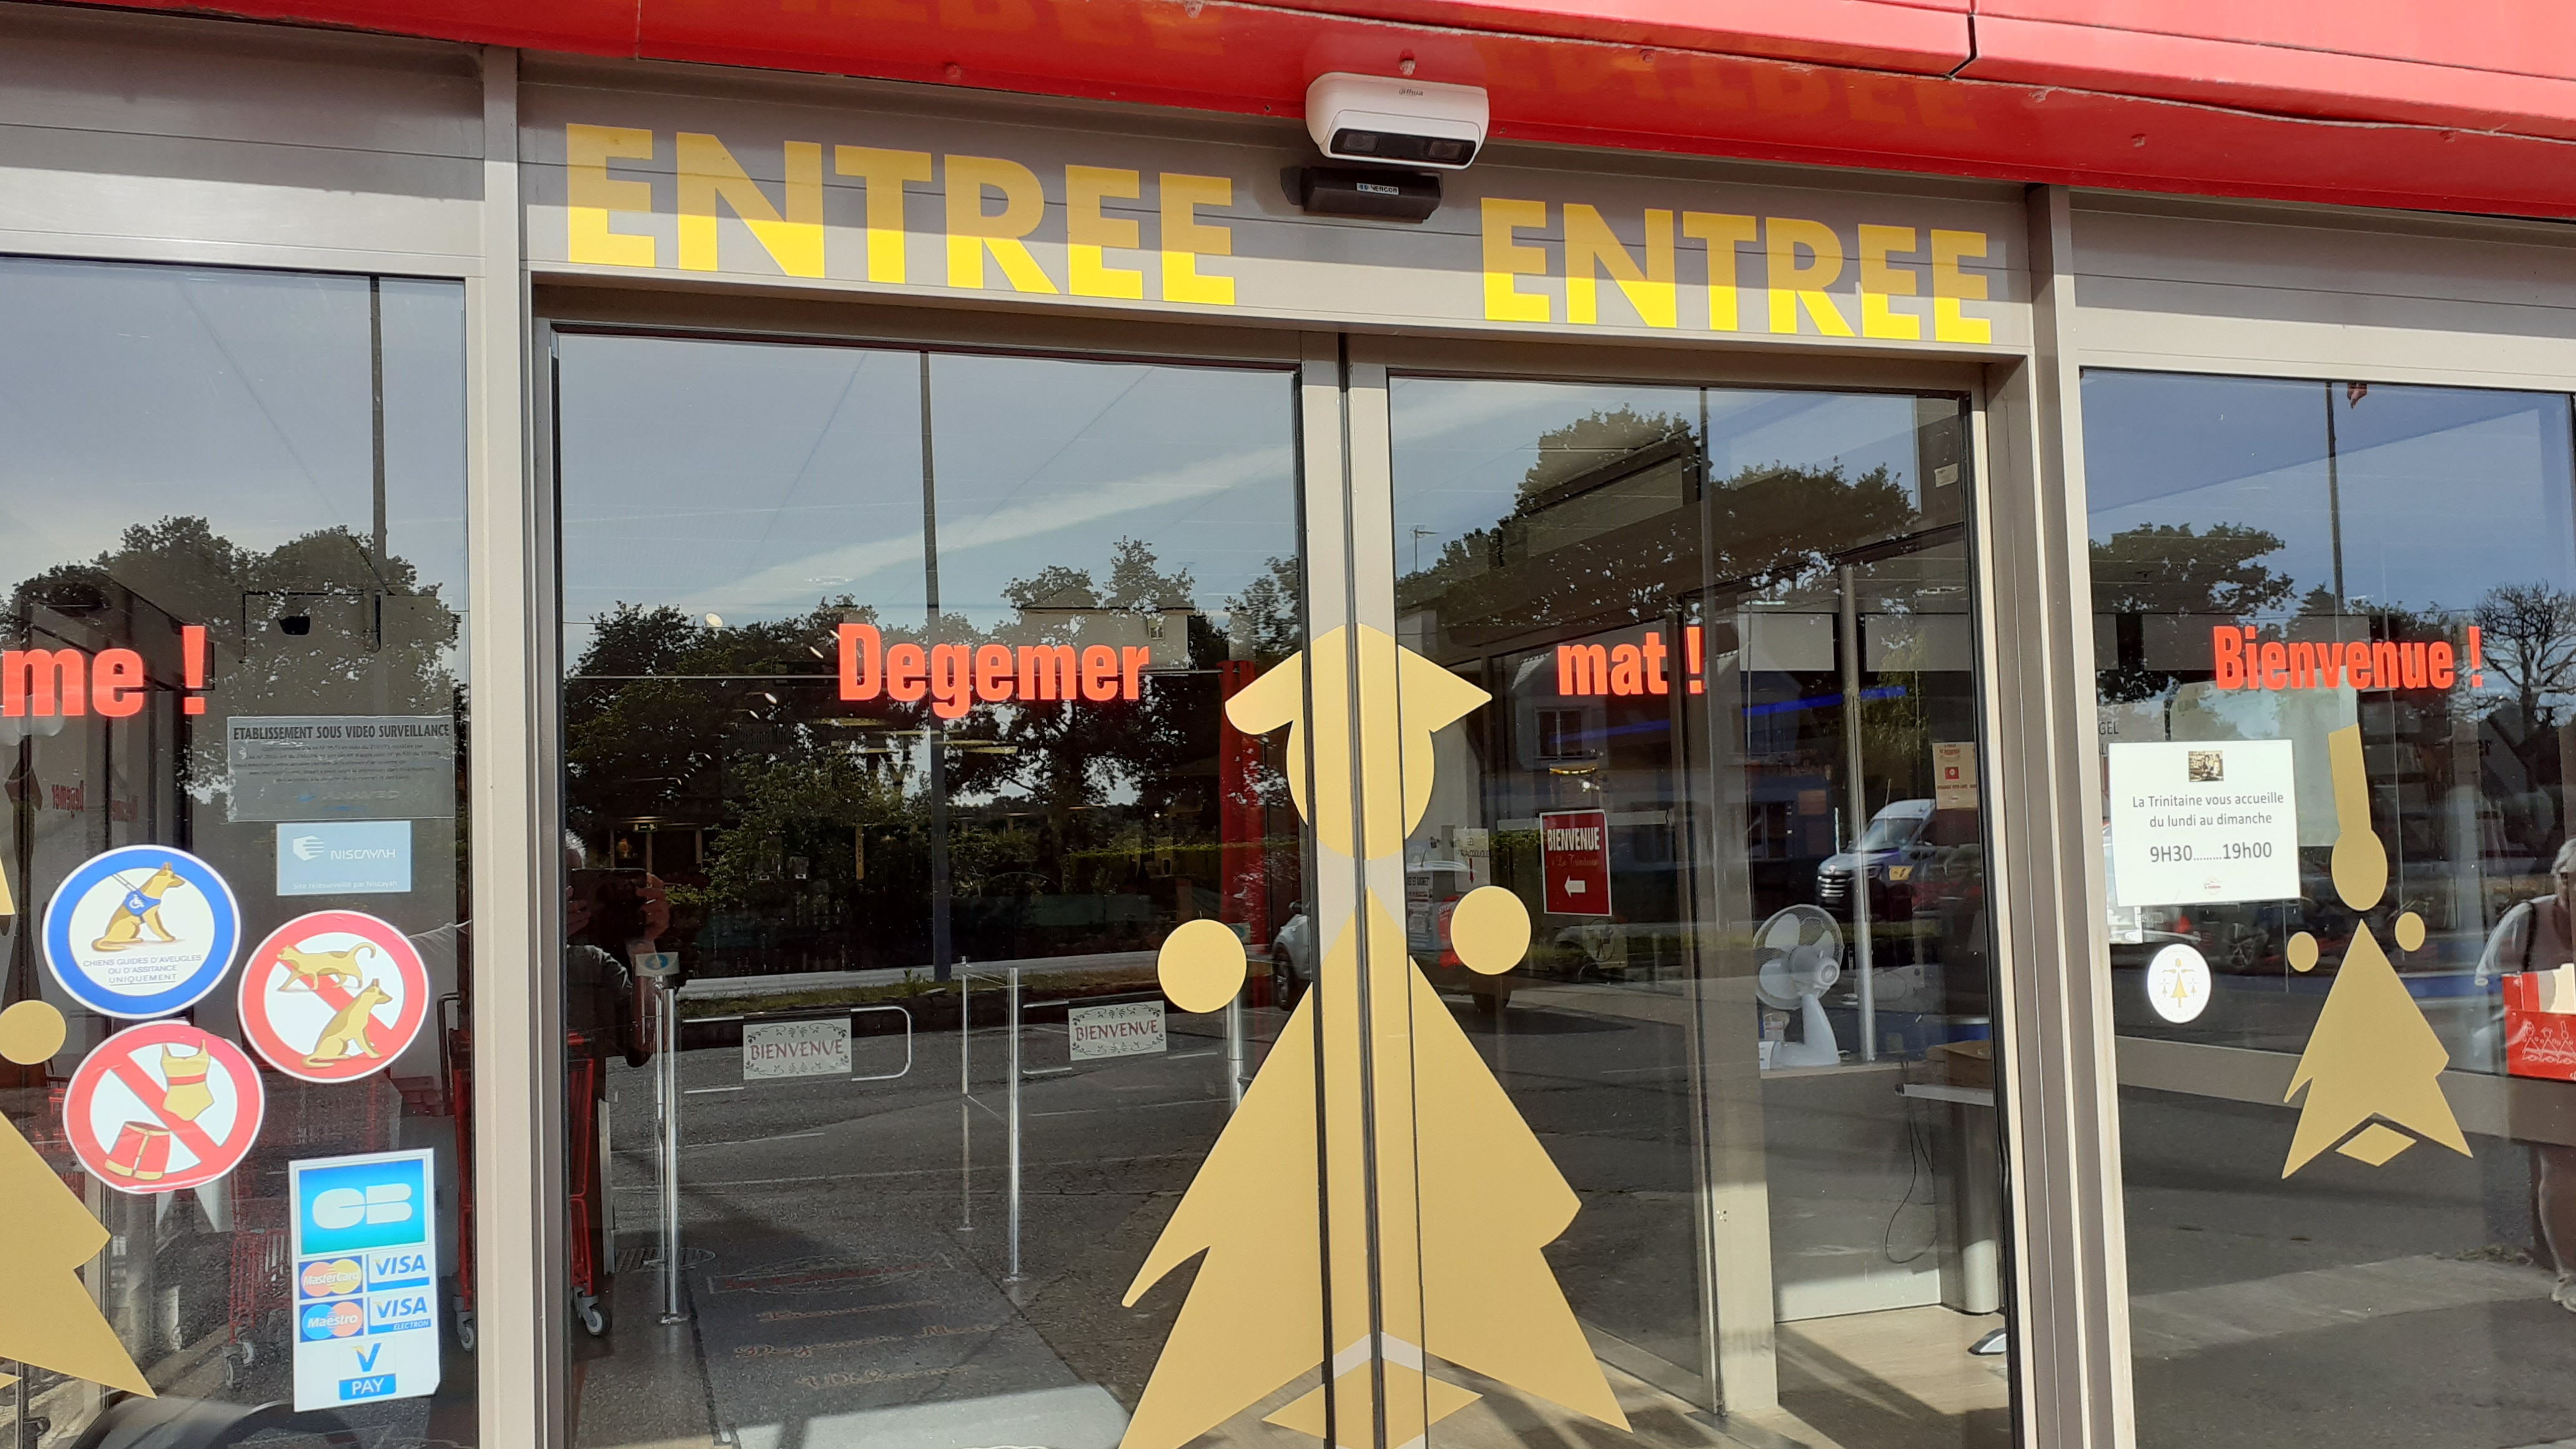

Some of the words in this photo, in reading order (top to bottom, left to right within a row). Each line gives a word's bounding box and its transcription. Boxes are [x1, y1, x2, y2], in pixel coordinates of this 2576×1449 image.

[566, 123, 1236, 305] ENTREE
[1481, 197, 1991, 344] ENTREE
[1558, 632, 1668, 695] mat
[1686, 626, 1704, 694] !
[2213, 626, 2454, 690] Bienvenue
[2469, 626, 2483, 687] !
[2, 648, 144, 717] me
[182, 626, 205, 715] !
[839, 623, 1149, 718] Degemer
[233, 726, 313, 740] ETABLISSEMENT
[316, 726, 342, 739] SOUS
[345, 725, 374, 738] VIDEO
[379, 724, 450, 738] SURVEILLANCE
[2098, 721, 2119, 735] GEL
[2132, 796, 2145, 807] La
[2148, 794, 2202, 807] Trinitaine
[2205, 796, 2232, 806] vous
[2235, 791, 2284, 804] accueille
[2150, 815, 2164, 827] du
[2168, 814, 2196, 827] lundi
[2200, 816, 2213, 826] au
[2217, 812, 2272, 825] dimanche
[1548, 827, 1600, 851] BIENVENUE
[331, 849, 396, 860] NISCAYAH
[366, 880, 398, 888] Niscayah
[83, 959, 115, 967] CHIENS
[117, 957, 149, 965] GUIDES
[150, 954, 202, 964] D'AVEUGLES
[124, 965, 177, 973] D'ASSITANCE
[109, 973, 177, 983] UNIQUEMENT
[1076, 1020, 1159, 1042] BIENVENUE
[750, 1038, 844, 1061] BIENVENUE
[374, 1254, 426, 1276] VISA
[303, 1269, 361, 1286] MasterCard
[376, 1297, 427, 1319] VISA
[308, 1313, 358, 1328] Maestro
[393, 1320, 429, 1330] ELECTRON
[351, 1378, 384, 1395] PAY
